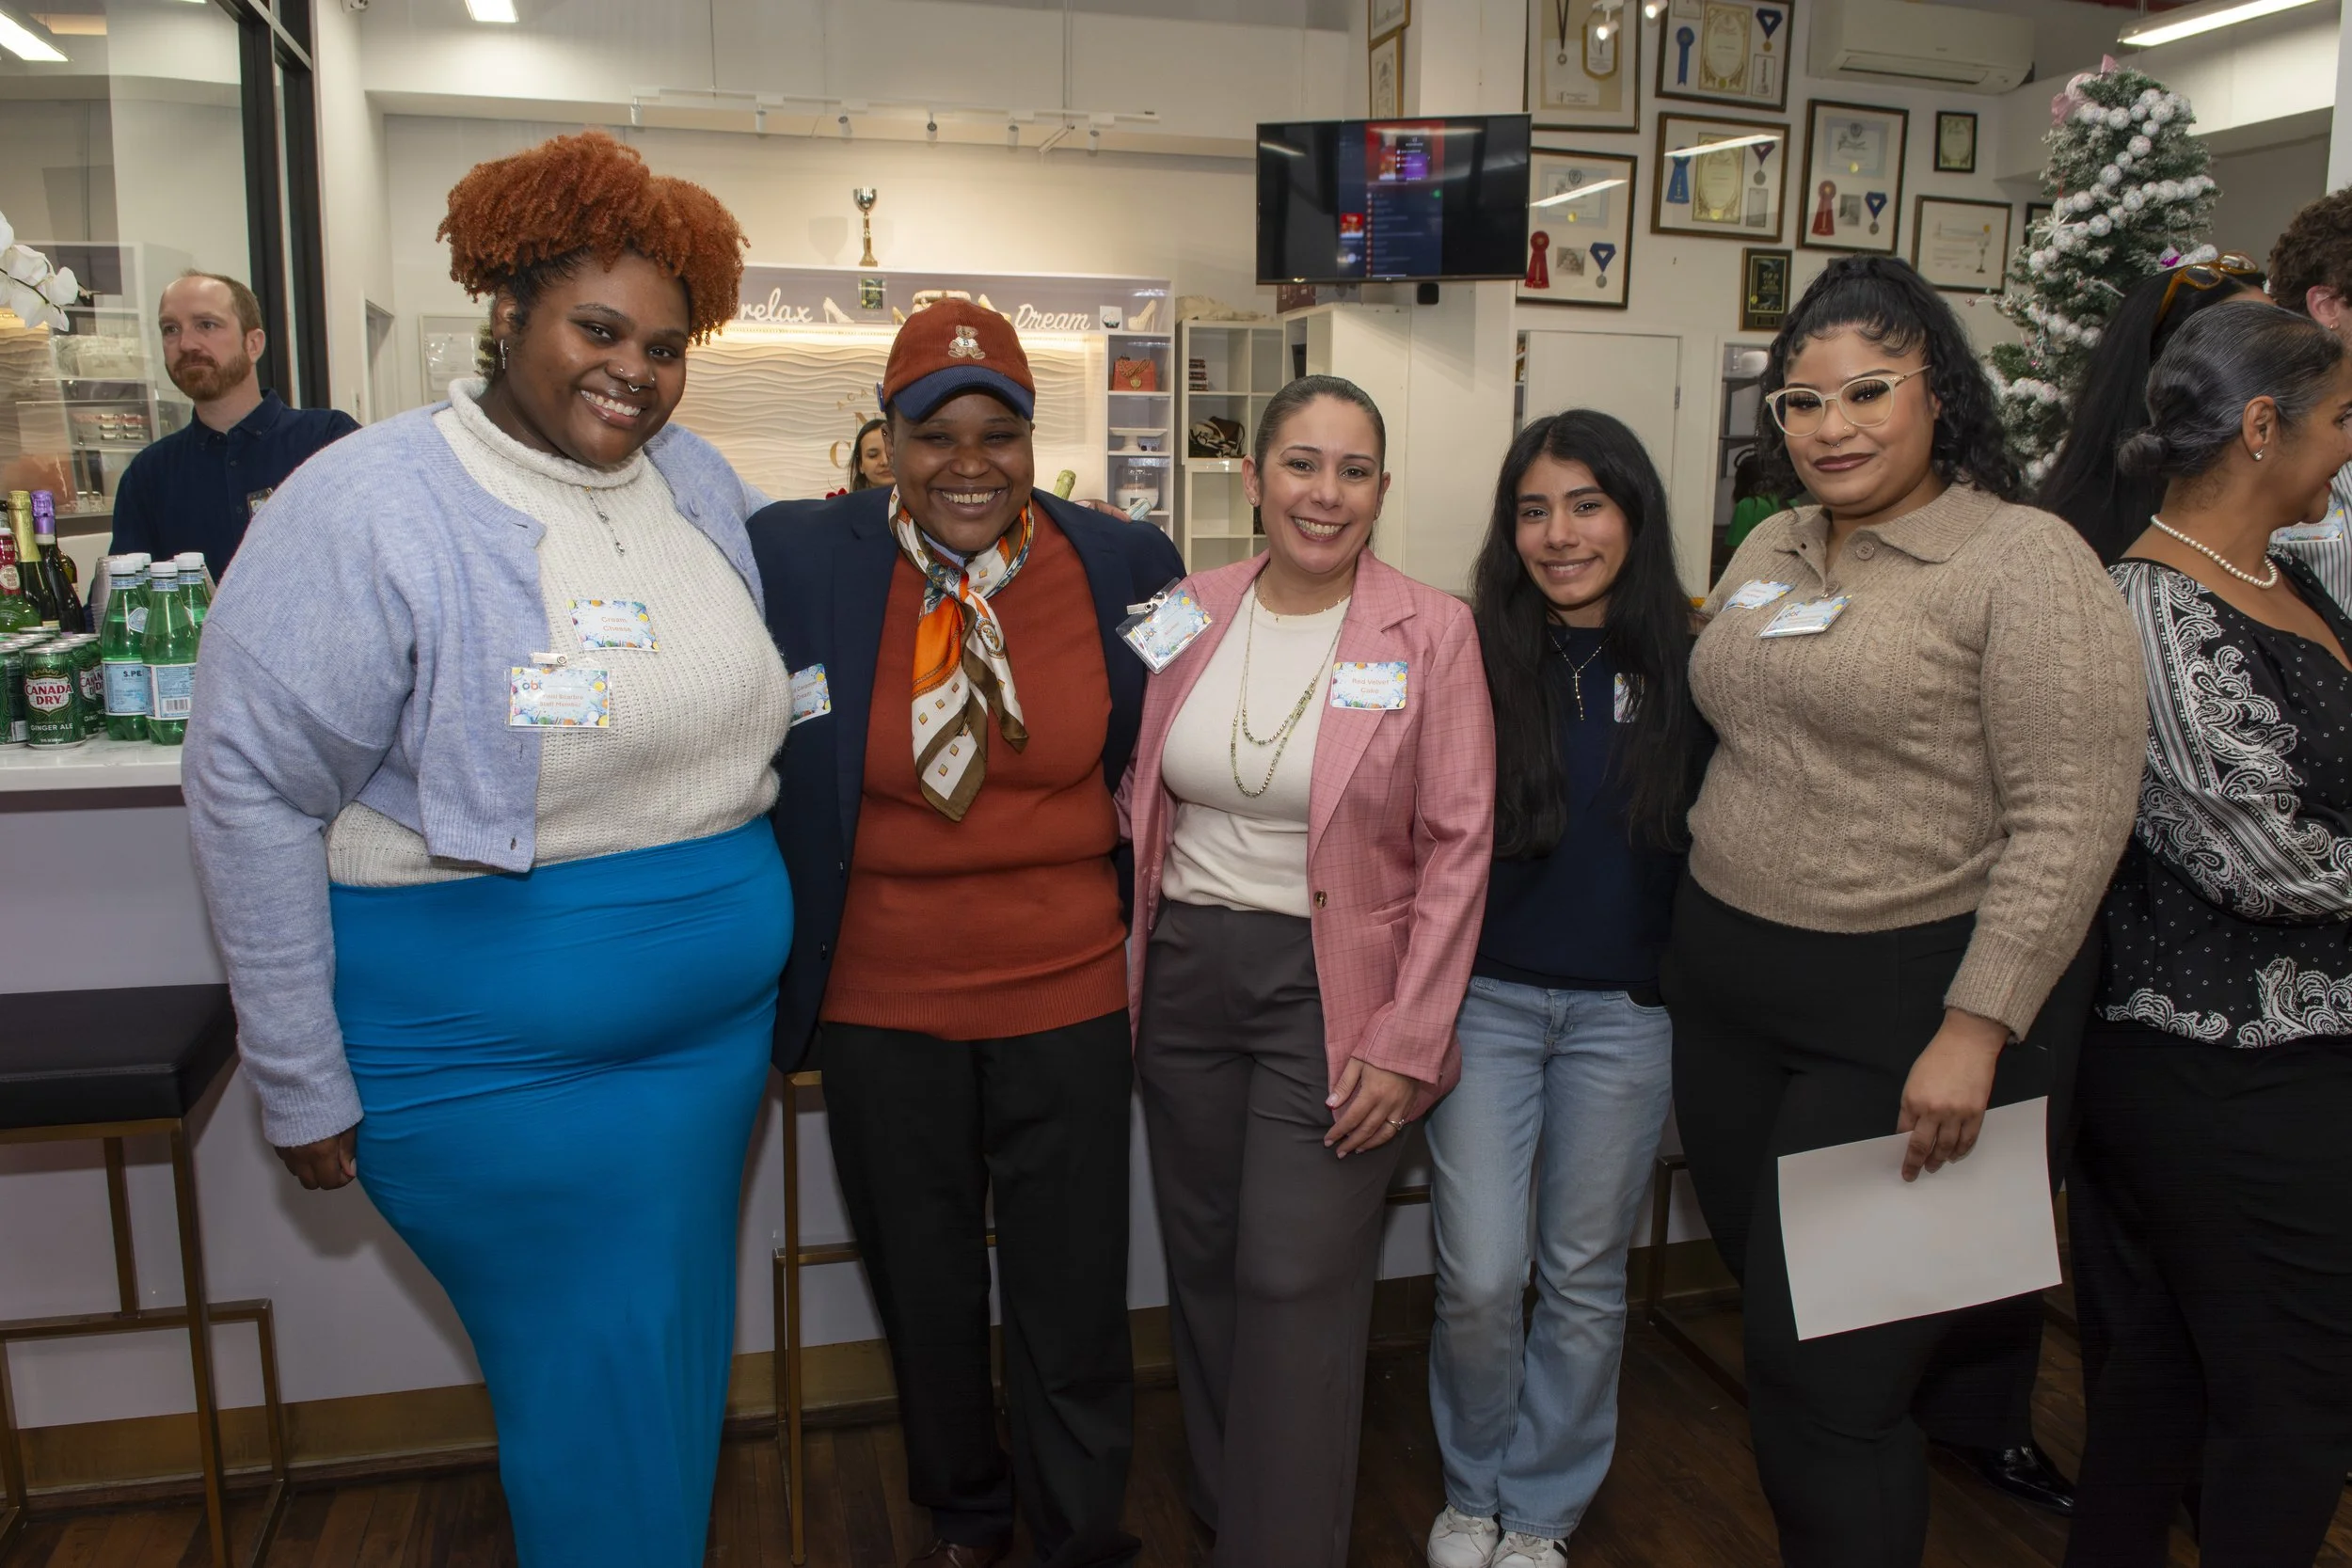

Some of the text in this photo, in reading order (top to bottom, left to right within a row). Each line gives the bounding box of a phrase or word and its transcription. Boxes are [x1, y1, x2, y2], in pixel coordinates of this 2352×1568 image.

[740, 287, 813, 324] relax
[1015, 303, 1091, 331] Dream
[24, 684, 73, 696] CANADA
[522, 680, 543, 690] obt
[36, 695, 62, 705] DRY
